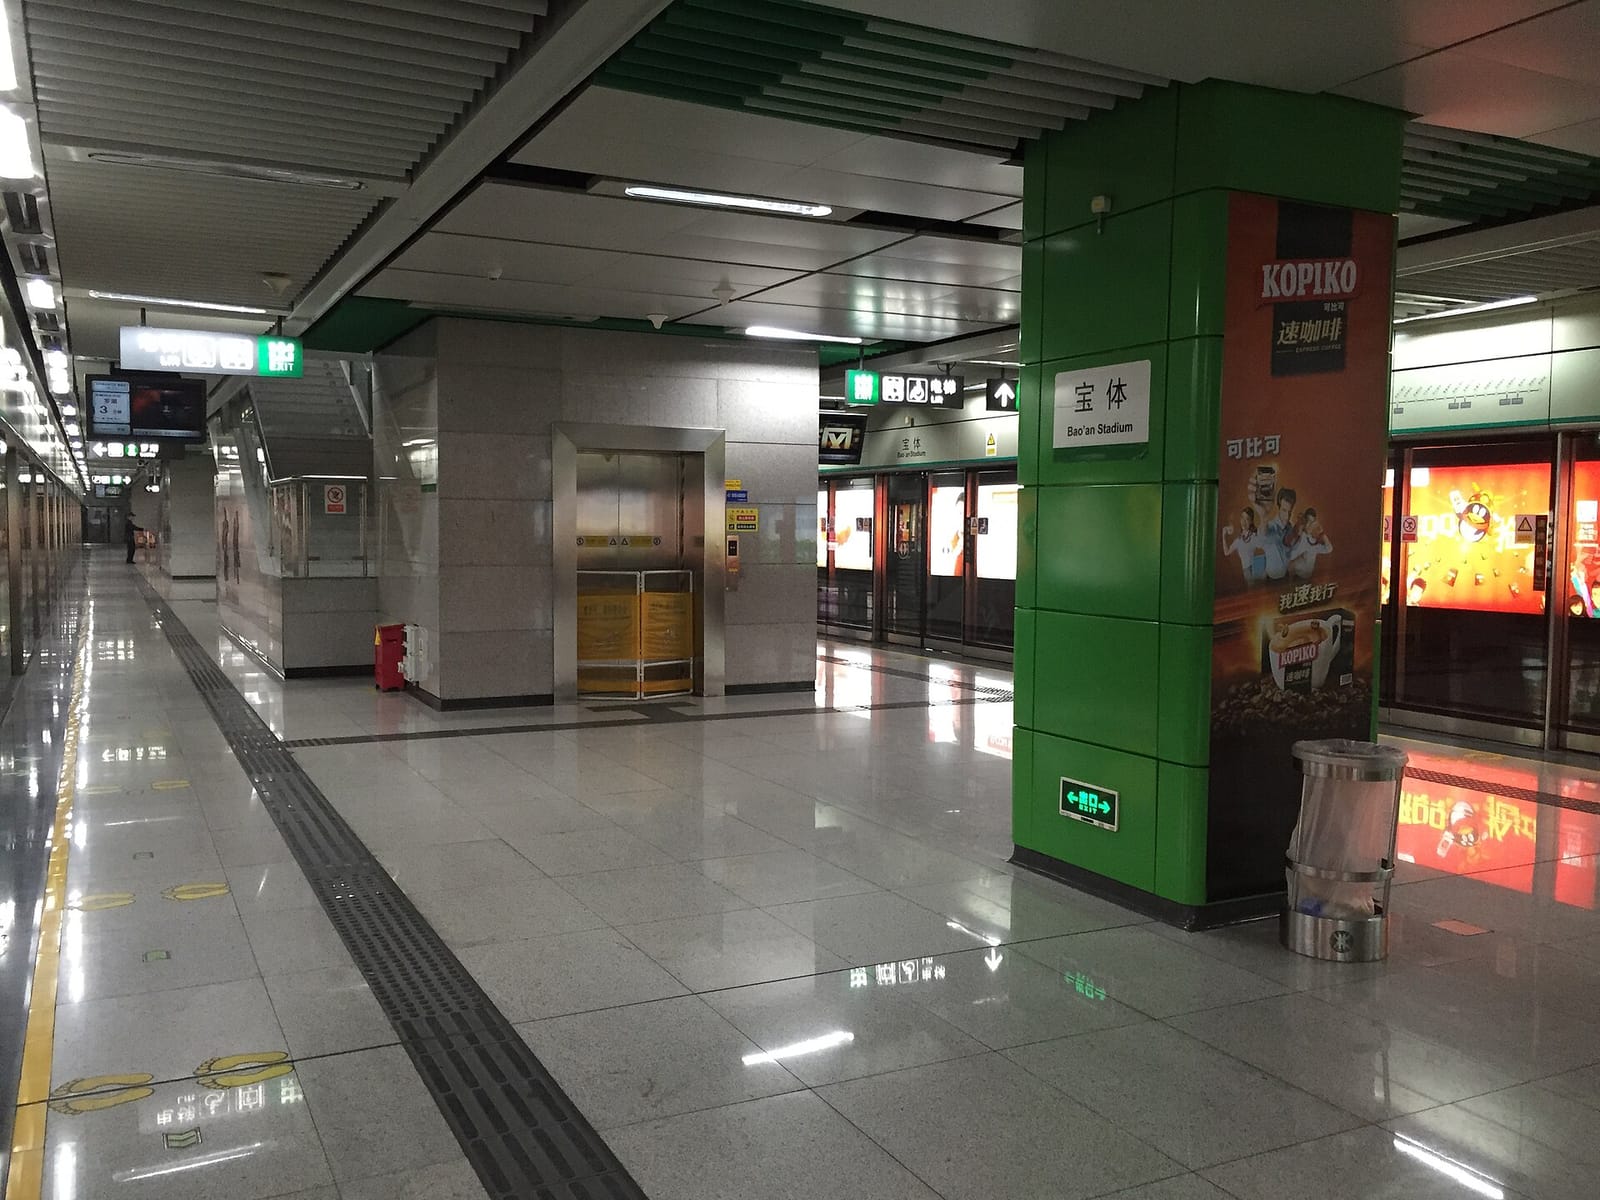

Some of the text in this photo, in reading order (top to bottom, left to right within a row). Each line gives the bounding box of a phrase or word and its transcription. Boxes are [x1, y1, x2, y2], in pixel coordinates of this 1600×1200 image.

[1261, 260, 1357, 298] KOPIKO
[1277, 317, 1343, 345] 速咖啡
[1074, 377, 1128, 413] 宝体
[1067, 421, 1133, 437] Bao'an Stadium
[1226, 434, 1281, 460] 可比可
[1280, 583, 1337, 610] 我速我行
[1281, 644, 1316, 666] KOPIKO
